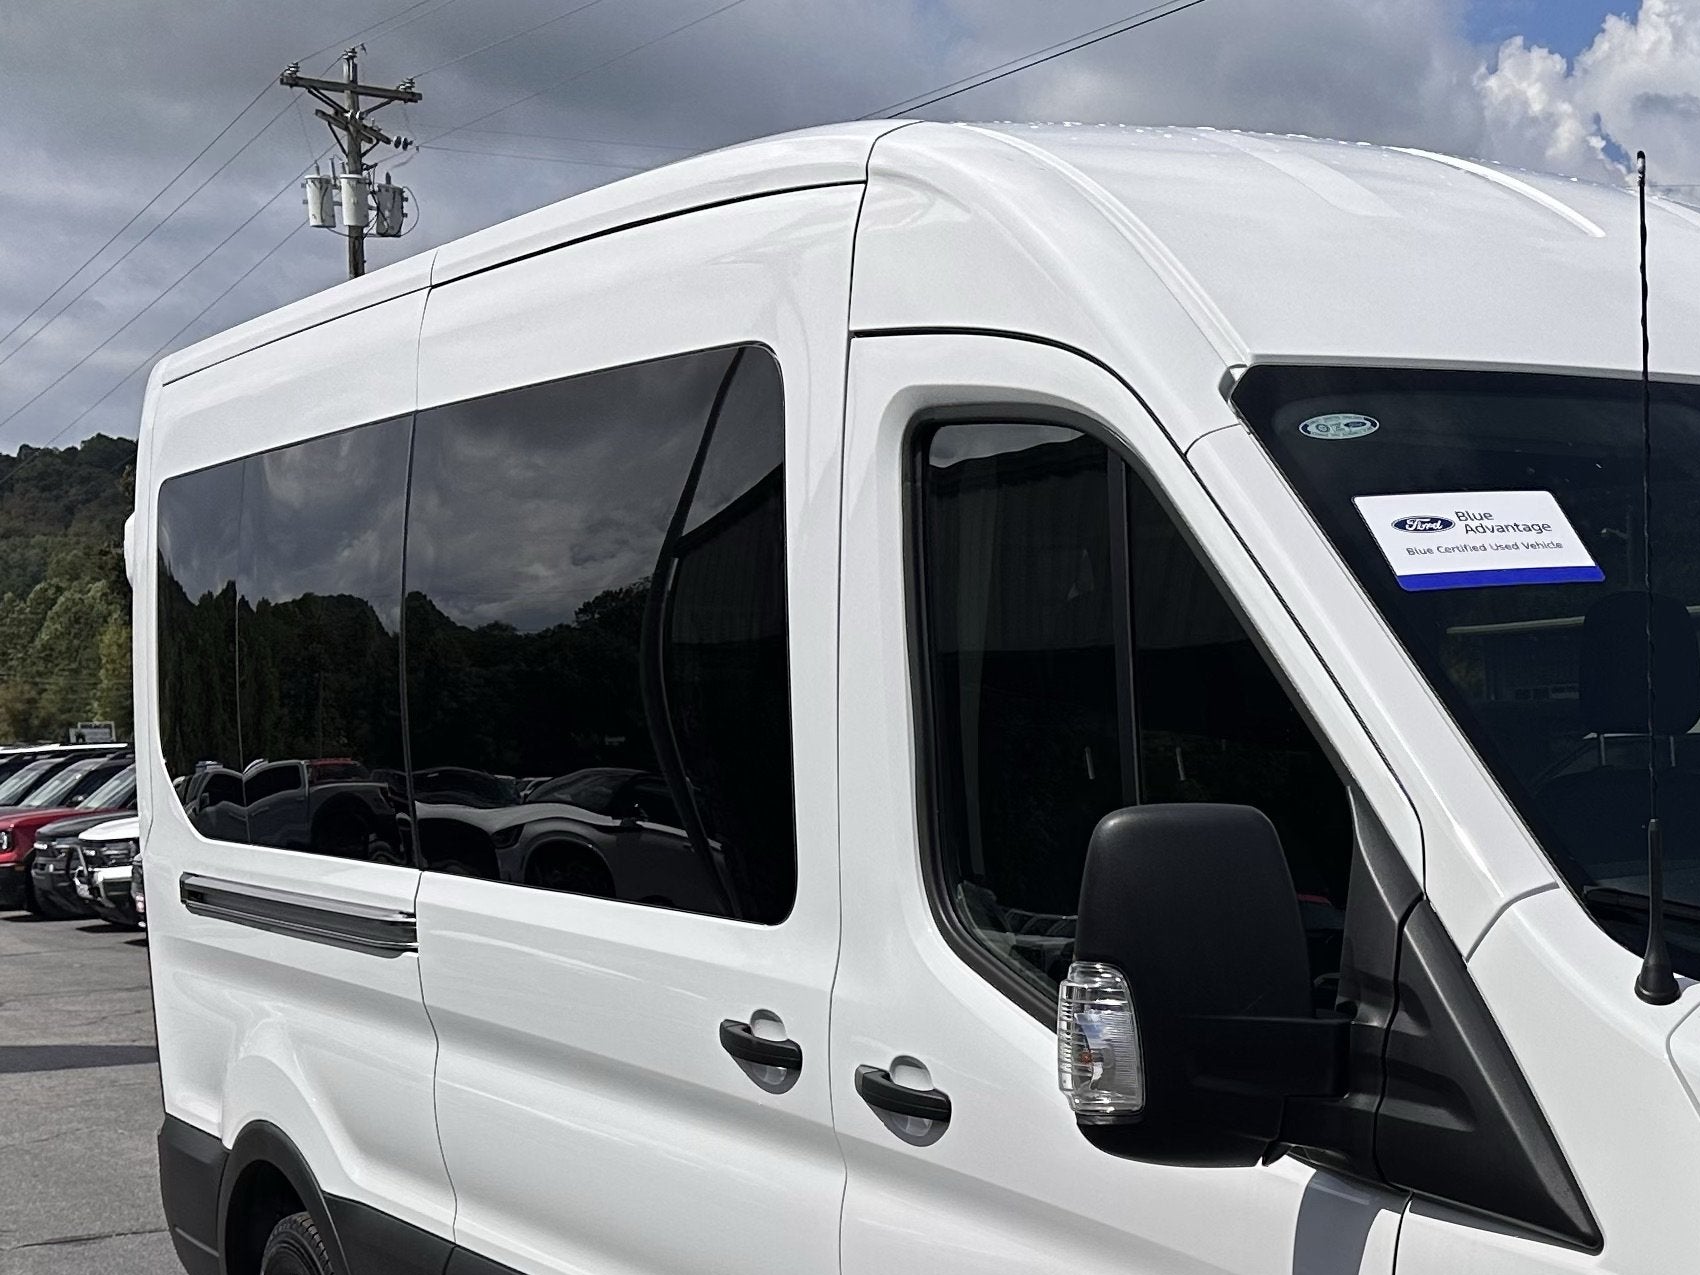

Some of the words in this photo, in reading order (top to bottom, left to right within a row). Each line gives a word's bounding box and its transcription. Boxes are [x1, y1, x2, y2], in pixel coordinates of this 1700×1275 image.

[1454, 510, 1494, 522] Blue
[1404, 518, 1444, 531] Ford
[1464, 521, 1553, 535] Advantage
[1406, 546, 1434, 556] Blue
[1436, 543, 1488, 554] Certified
[1489, 541, 1520, 551] Used
[1521, 540, 1564, 550] Vehicle
